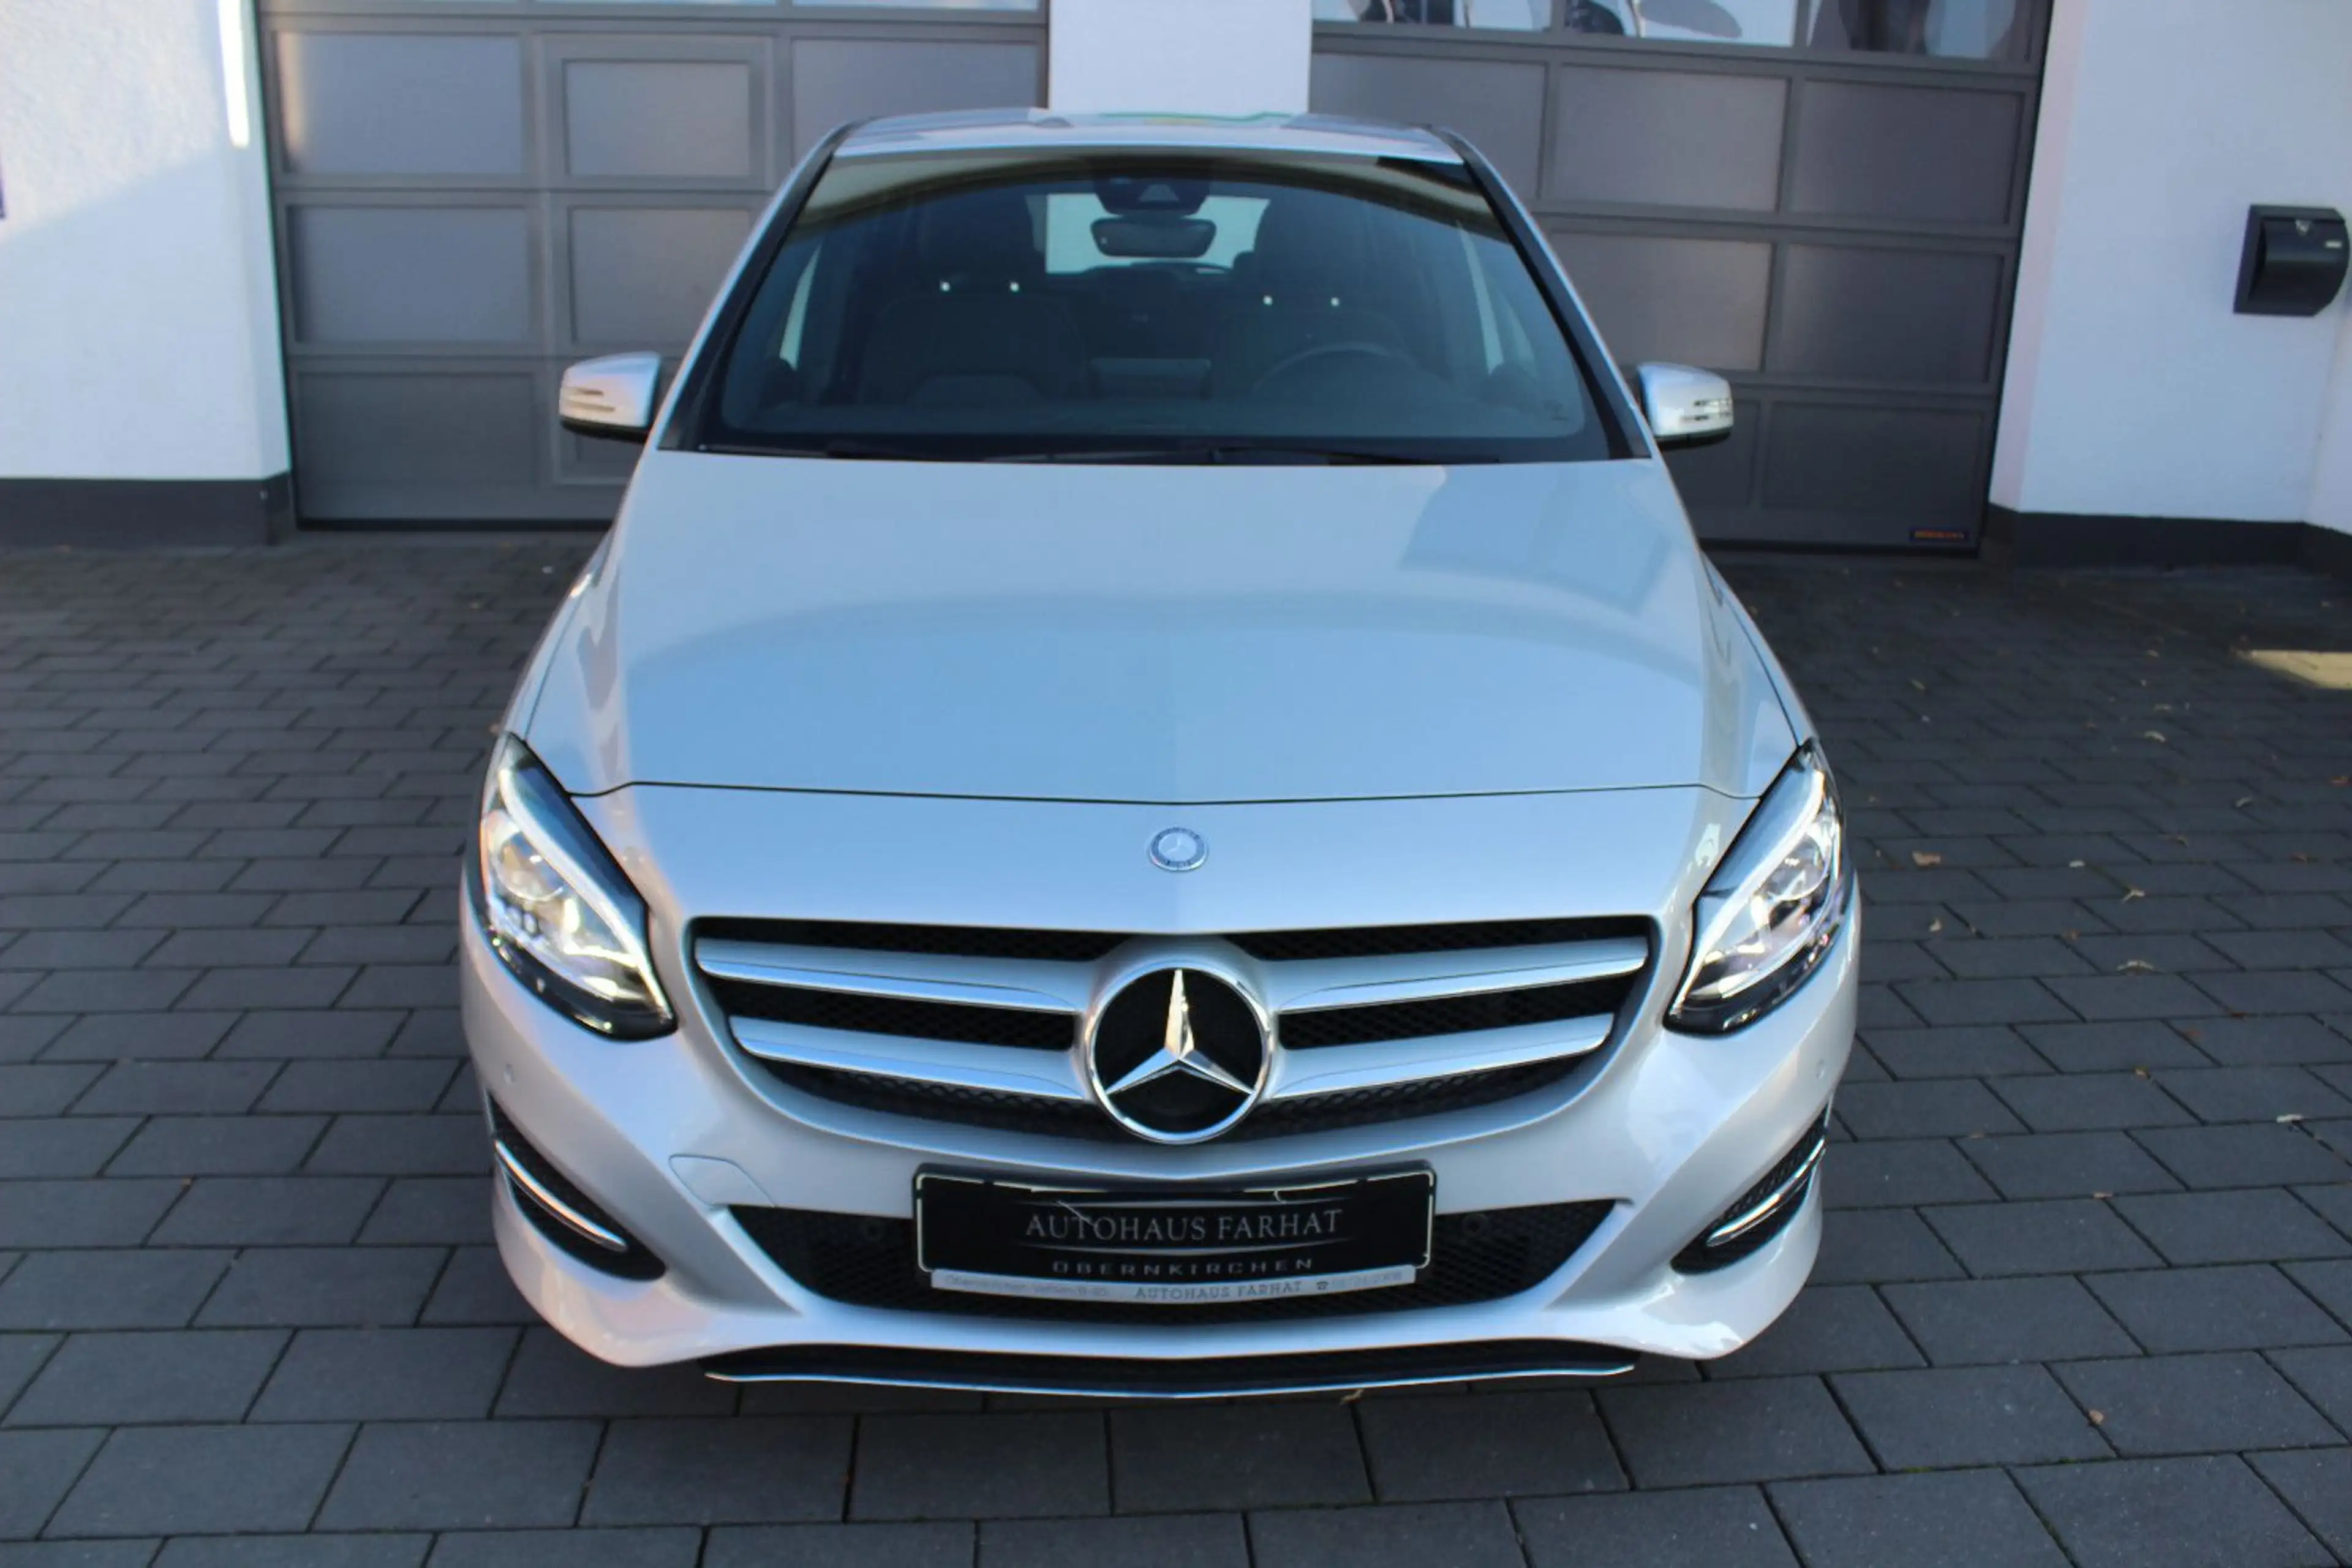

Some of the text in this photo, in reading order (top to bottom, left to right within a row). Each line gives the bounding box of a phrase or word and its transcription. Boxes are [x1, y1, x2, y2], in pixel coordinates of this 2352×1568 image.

[1026, 1208, 1343, 1241] AUTOHAUS FARHAT
[1052, 1258, 1312, 1276] OBERNKIRCHEN
[1135, 1281, 1302, 1301] AUTOHAUS FARHAT
